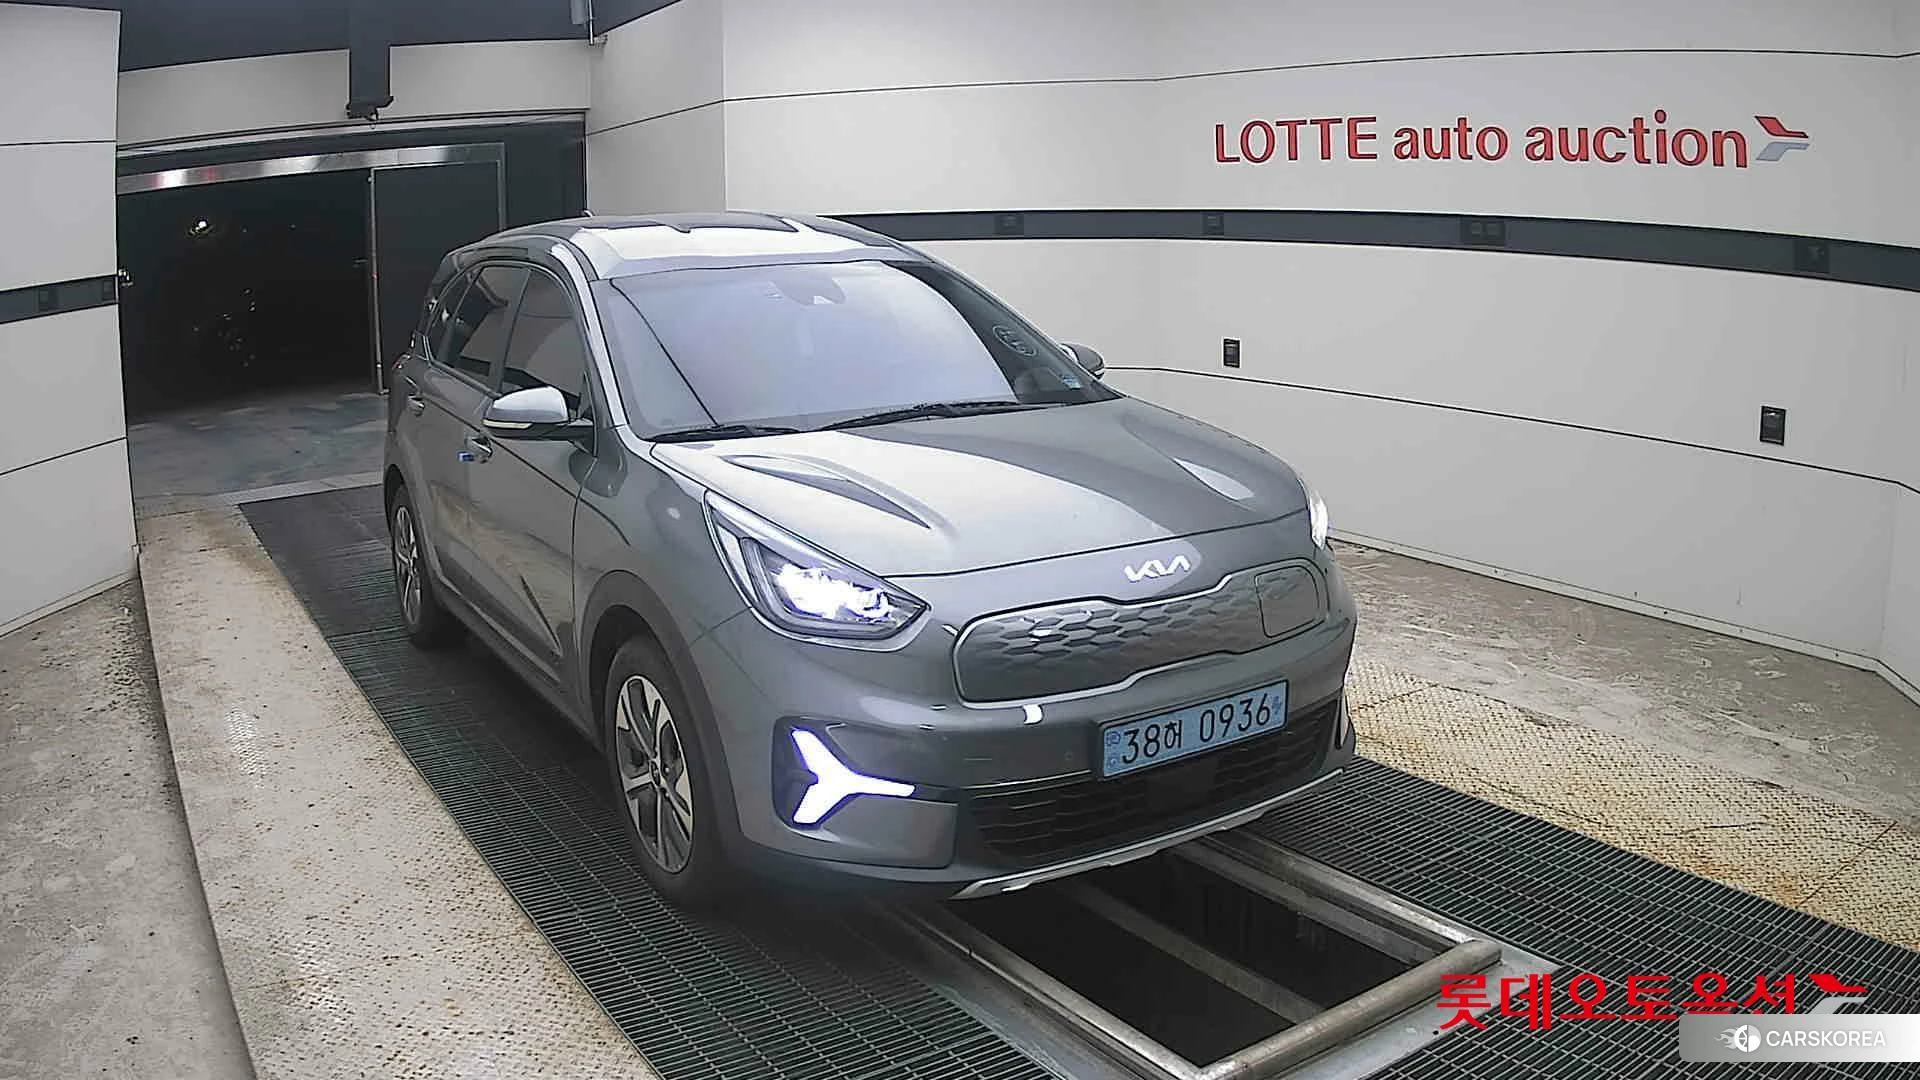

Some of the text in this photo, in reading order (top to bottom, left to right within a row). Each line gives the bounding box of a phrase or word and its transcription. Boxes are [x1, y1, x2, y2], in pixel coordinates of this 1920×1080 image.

[1214, 108, 1748, 168] LOTTE auto auction
[1122, 692, 1271, 764] 38허 0936
